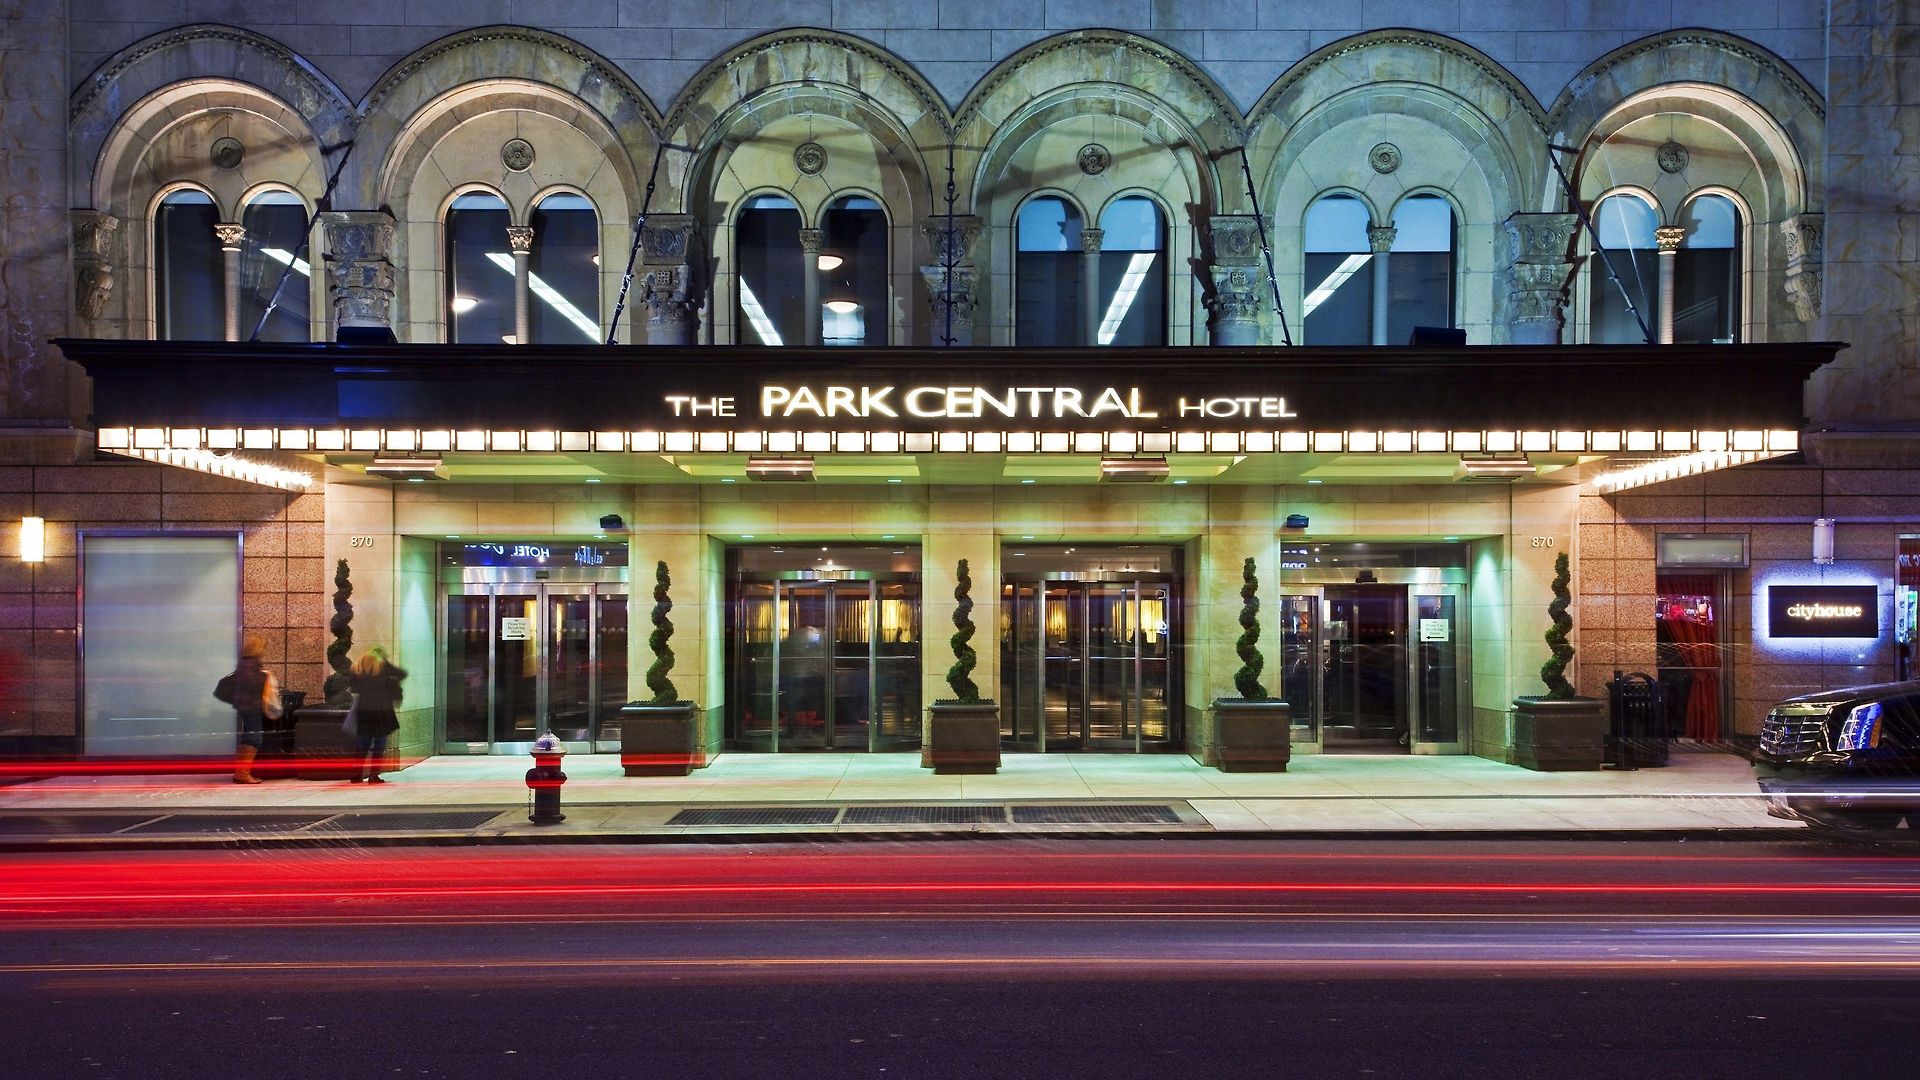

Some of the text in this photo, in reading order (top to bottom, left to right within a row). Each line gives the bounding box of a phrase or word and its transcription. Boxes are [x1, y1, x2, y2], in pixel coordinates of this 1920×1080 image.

[665, 386, 1297, 418] THE PARK CENTRAL HOTEL
[350, 536, 374, 547] 870
[1531, 536, 1555, 547] 870
[1786, 602, 1863, 621] cityhouse
